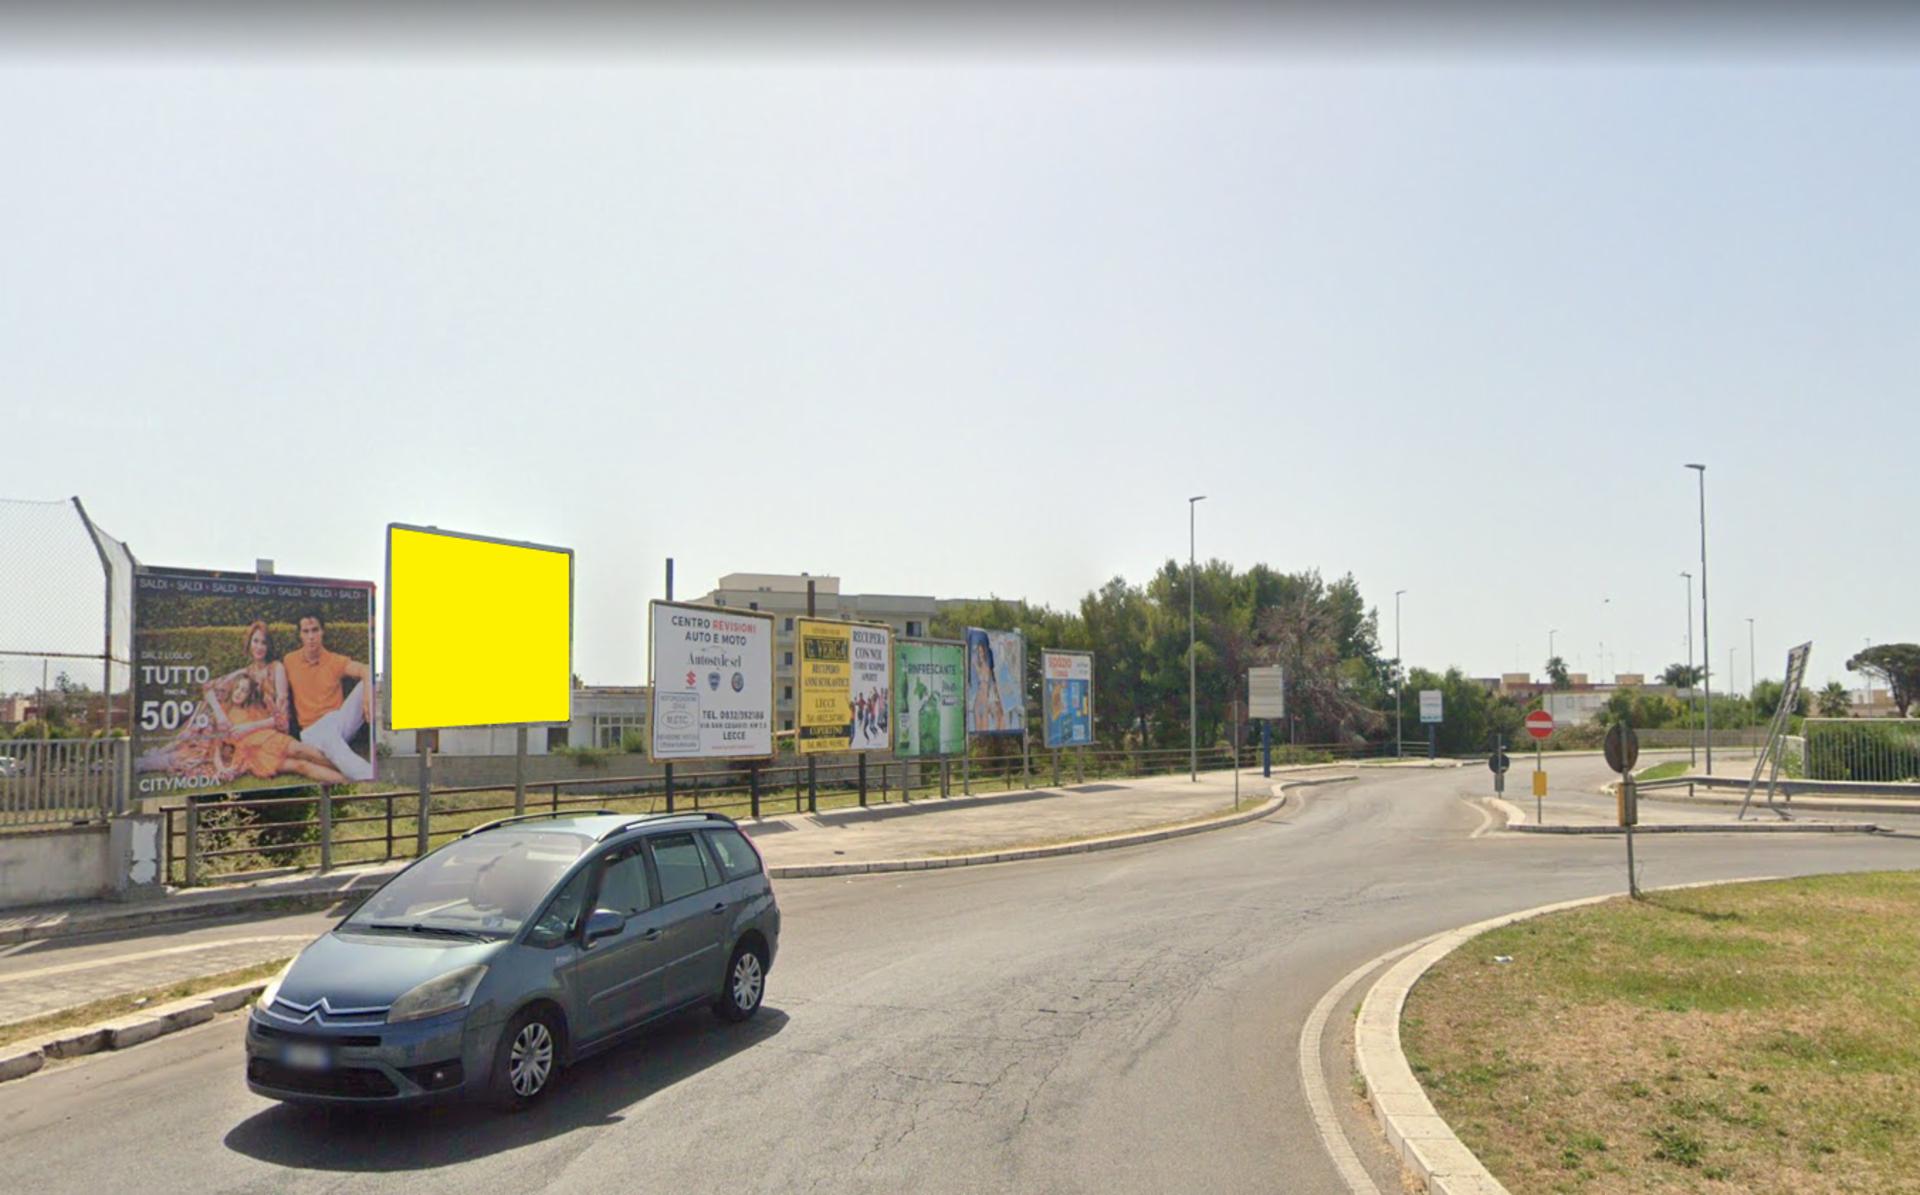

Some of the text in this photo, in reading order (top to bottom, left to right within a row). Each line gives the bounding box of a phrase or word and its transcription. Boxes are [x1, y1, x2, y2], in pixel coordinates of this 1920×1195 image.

[139, 578, 361, 599] SALDI SALDI SALDI SALDI SALDI SALDI SALDI
[671, 615, 757, 634] CENTRO REVISIONI
[685, 631, 747, 646] AUTO E MOTO
[852, 631, 886, 645] RECUPERA
[855, 647, 869, 659] CON
[869, 648, 882, 661] NOI
[141, 666, 210, 685] TUTTO
[140, 700, 209, 730] 50%
[723, 731, 746, 741] LECCE
[139, 773, 221, 793] CITYMODA
